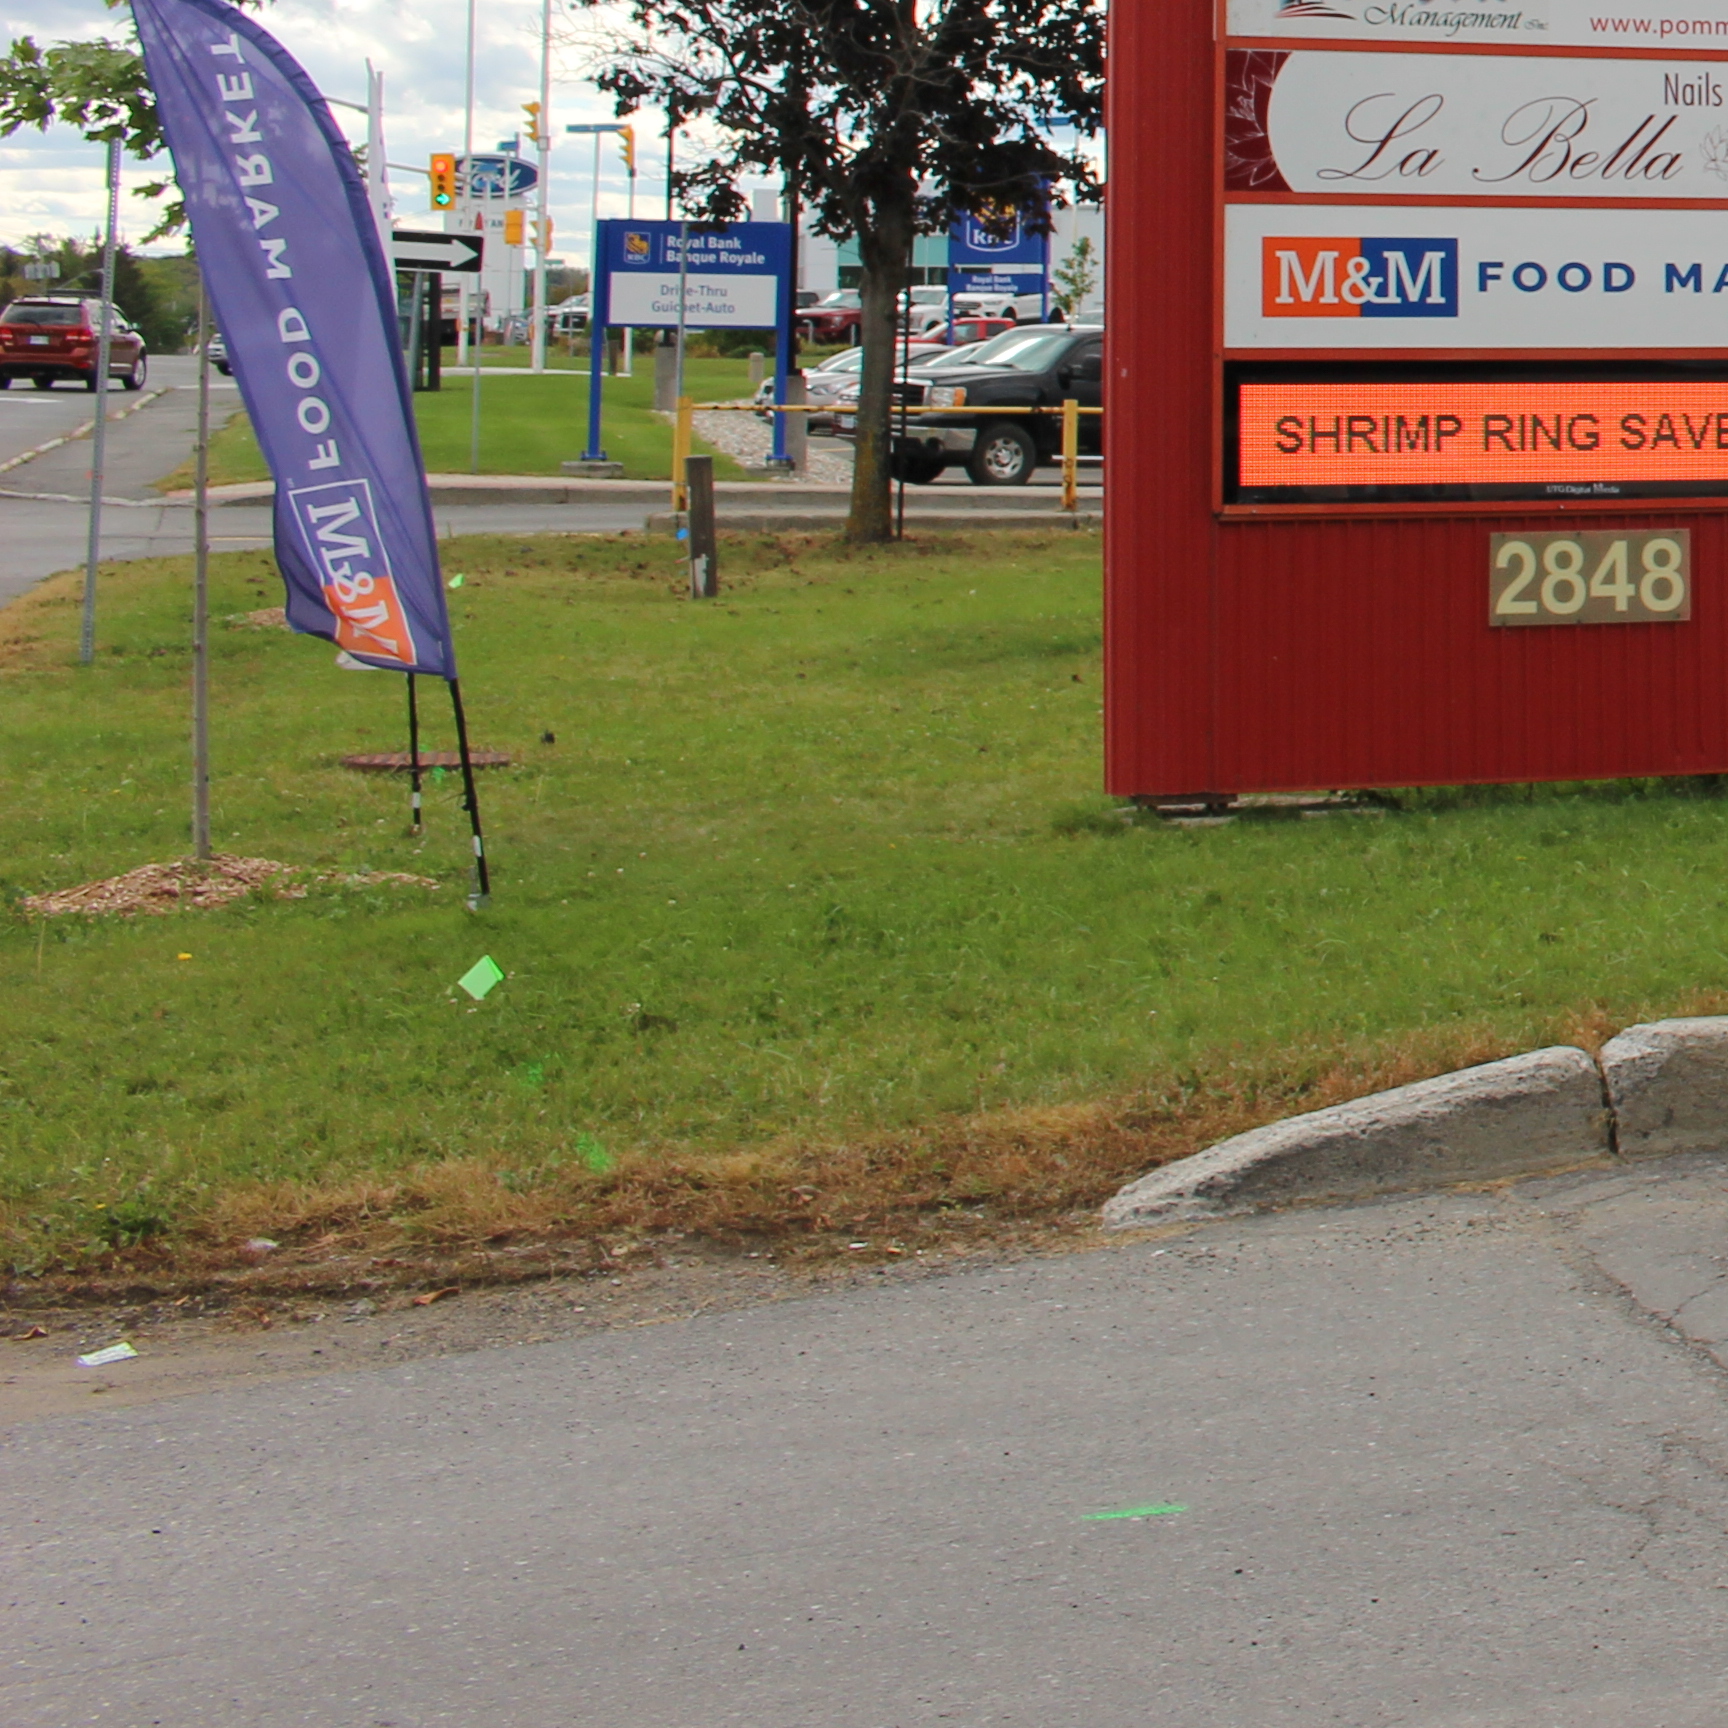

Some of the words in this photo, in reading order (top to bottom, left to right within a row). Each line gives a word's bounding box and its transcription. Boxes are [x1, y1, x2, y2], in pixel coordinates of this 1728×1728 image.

[1364, 0, 1522, 38] Management
[1663, 72, 1724, 108] Nails
[1316, 92, 1445, 182] La
[1472, 96, 1684, 184] Bella
[665, 250, 717, 266] Banque
[719, 253, 766, 267] Royale
[707, 235, 742, 250] Bank
[1274, 250, 1448, 306] M&M
[1477, 261, 1637, 294] FOOD
[1274, 414, 1463, 456] SHRIMP
[1482, 413, 1602, 452] RING
[1494, 538, 1687, 616] 2848
